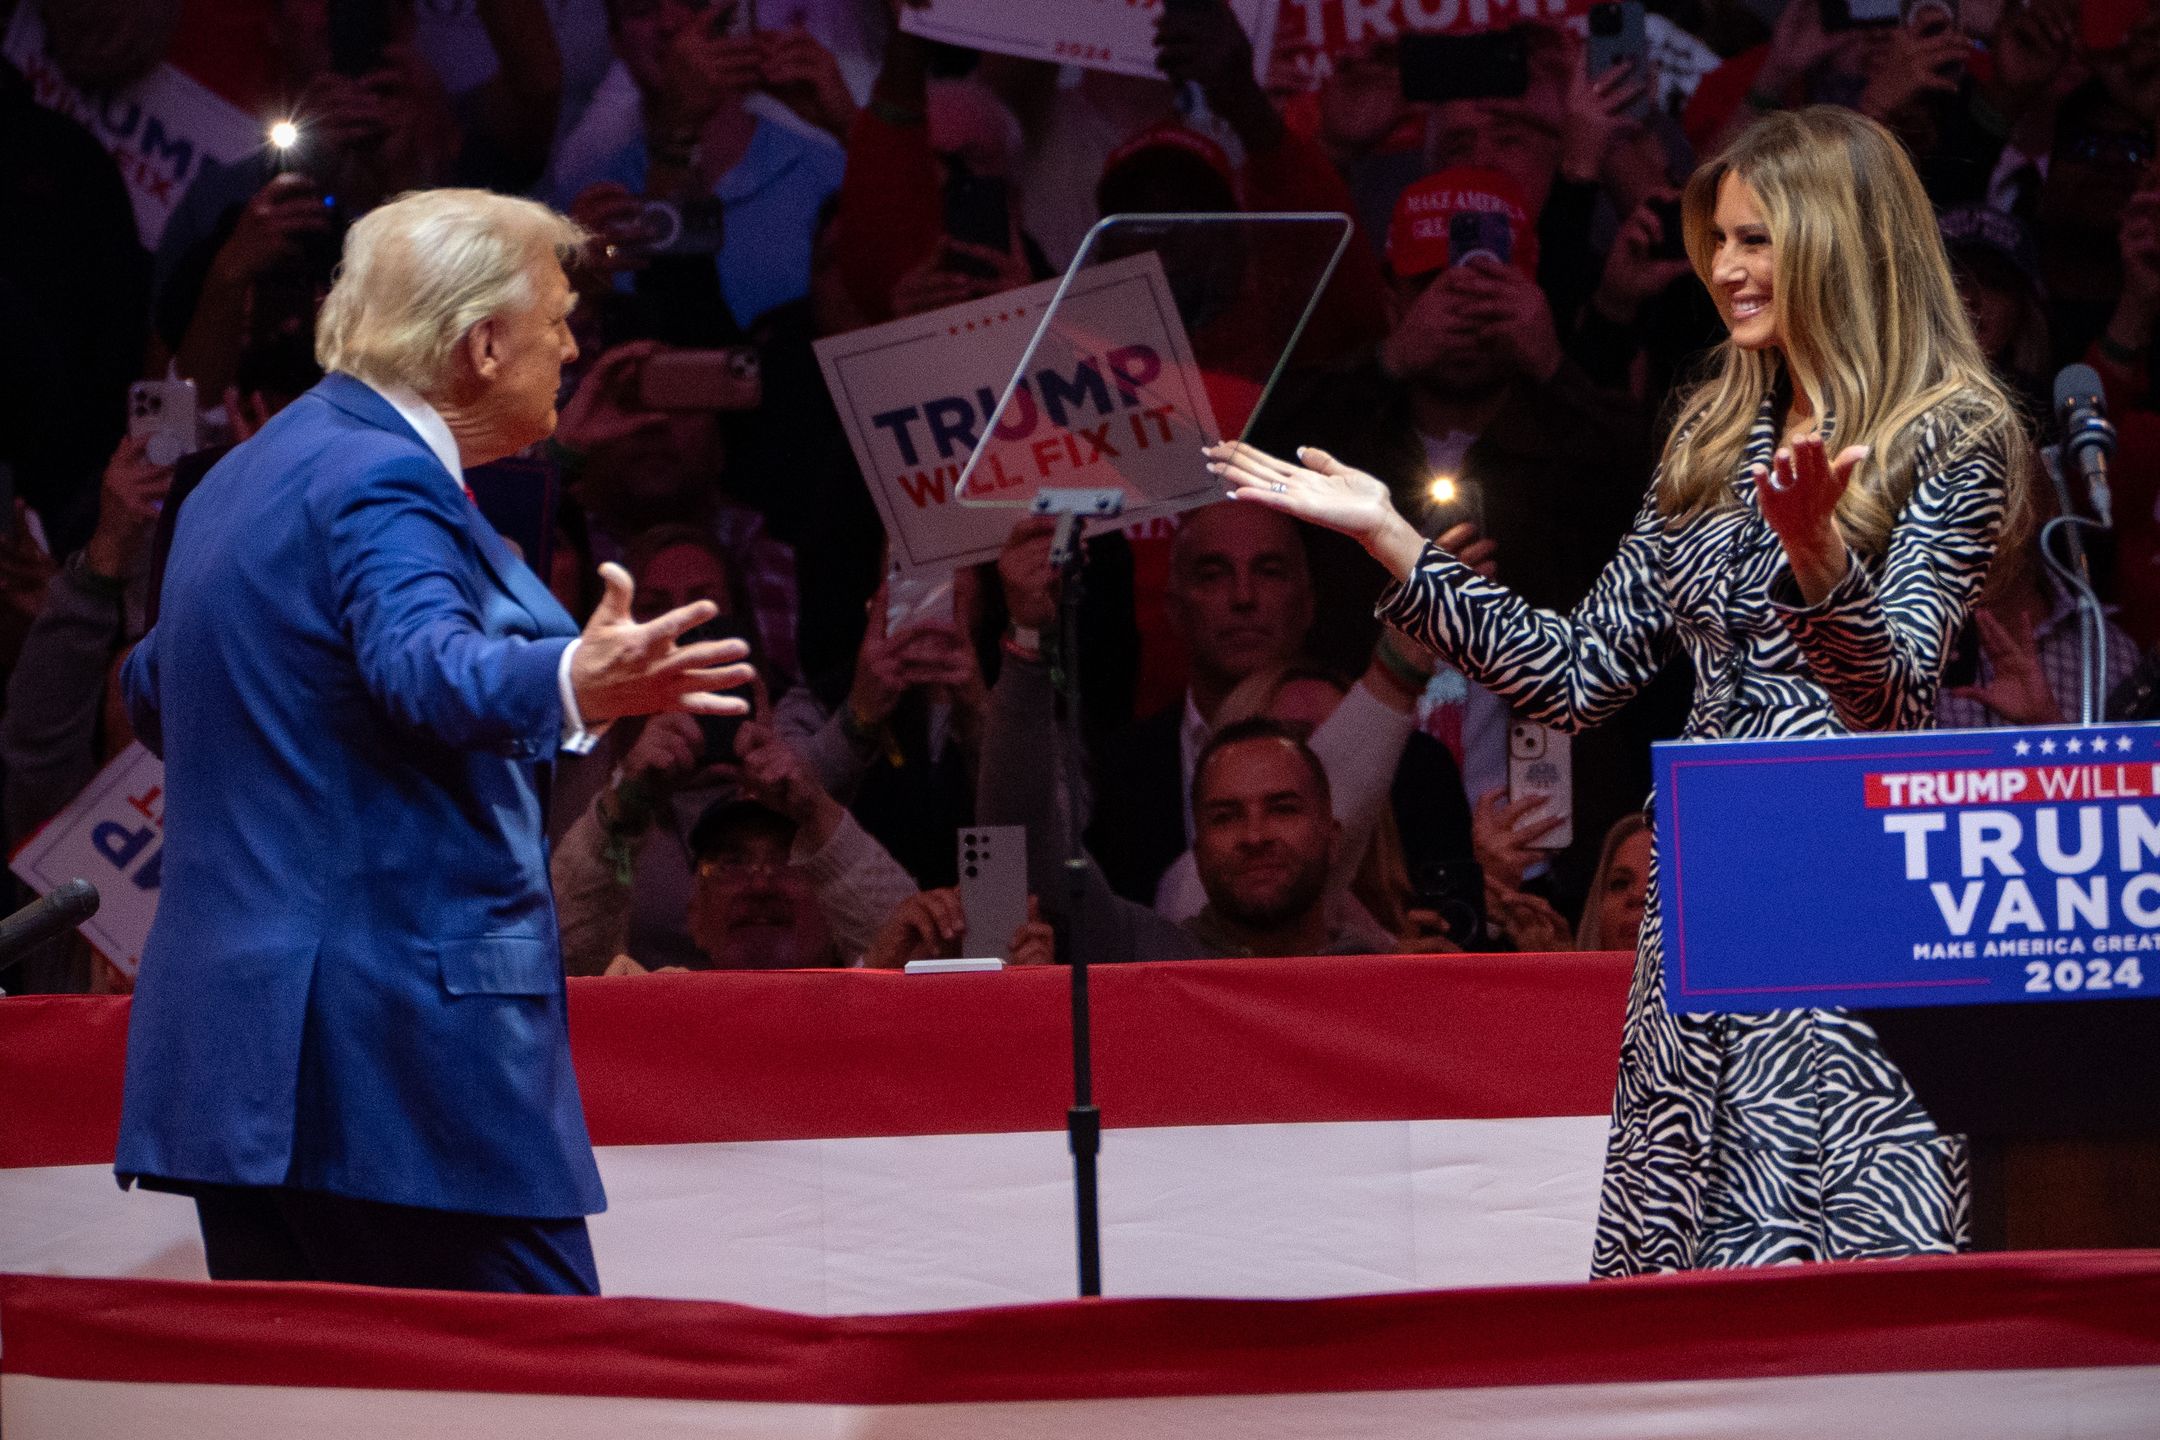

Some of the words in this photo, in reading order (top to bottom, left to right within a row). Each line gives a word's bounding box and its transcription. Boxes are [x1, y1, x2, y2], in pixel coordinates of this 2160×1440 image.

[1289, 0, 1567, 46] TRU
[873, 344, 1161, 466] TRUMP
[898, 454, 1025, 509] WILL
[1031, 417, 1120, 477] FIX
[1129, 404, 1175, 449] IT
[1880, 767, 2029, 807] TRUMP
[2036, 763, 2143, 800] WILL
[1882, 803, 2160, 881] TRUM
[1929, 872, 2160, 937] VANC
[1912, 941, 1976, 961] MAKE
[1982, 936, 2086, 958] AMERICA
[2091, 933, 2160, 953] GREAT
[2024, 956, 2144, 993] 2024
